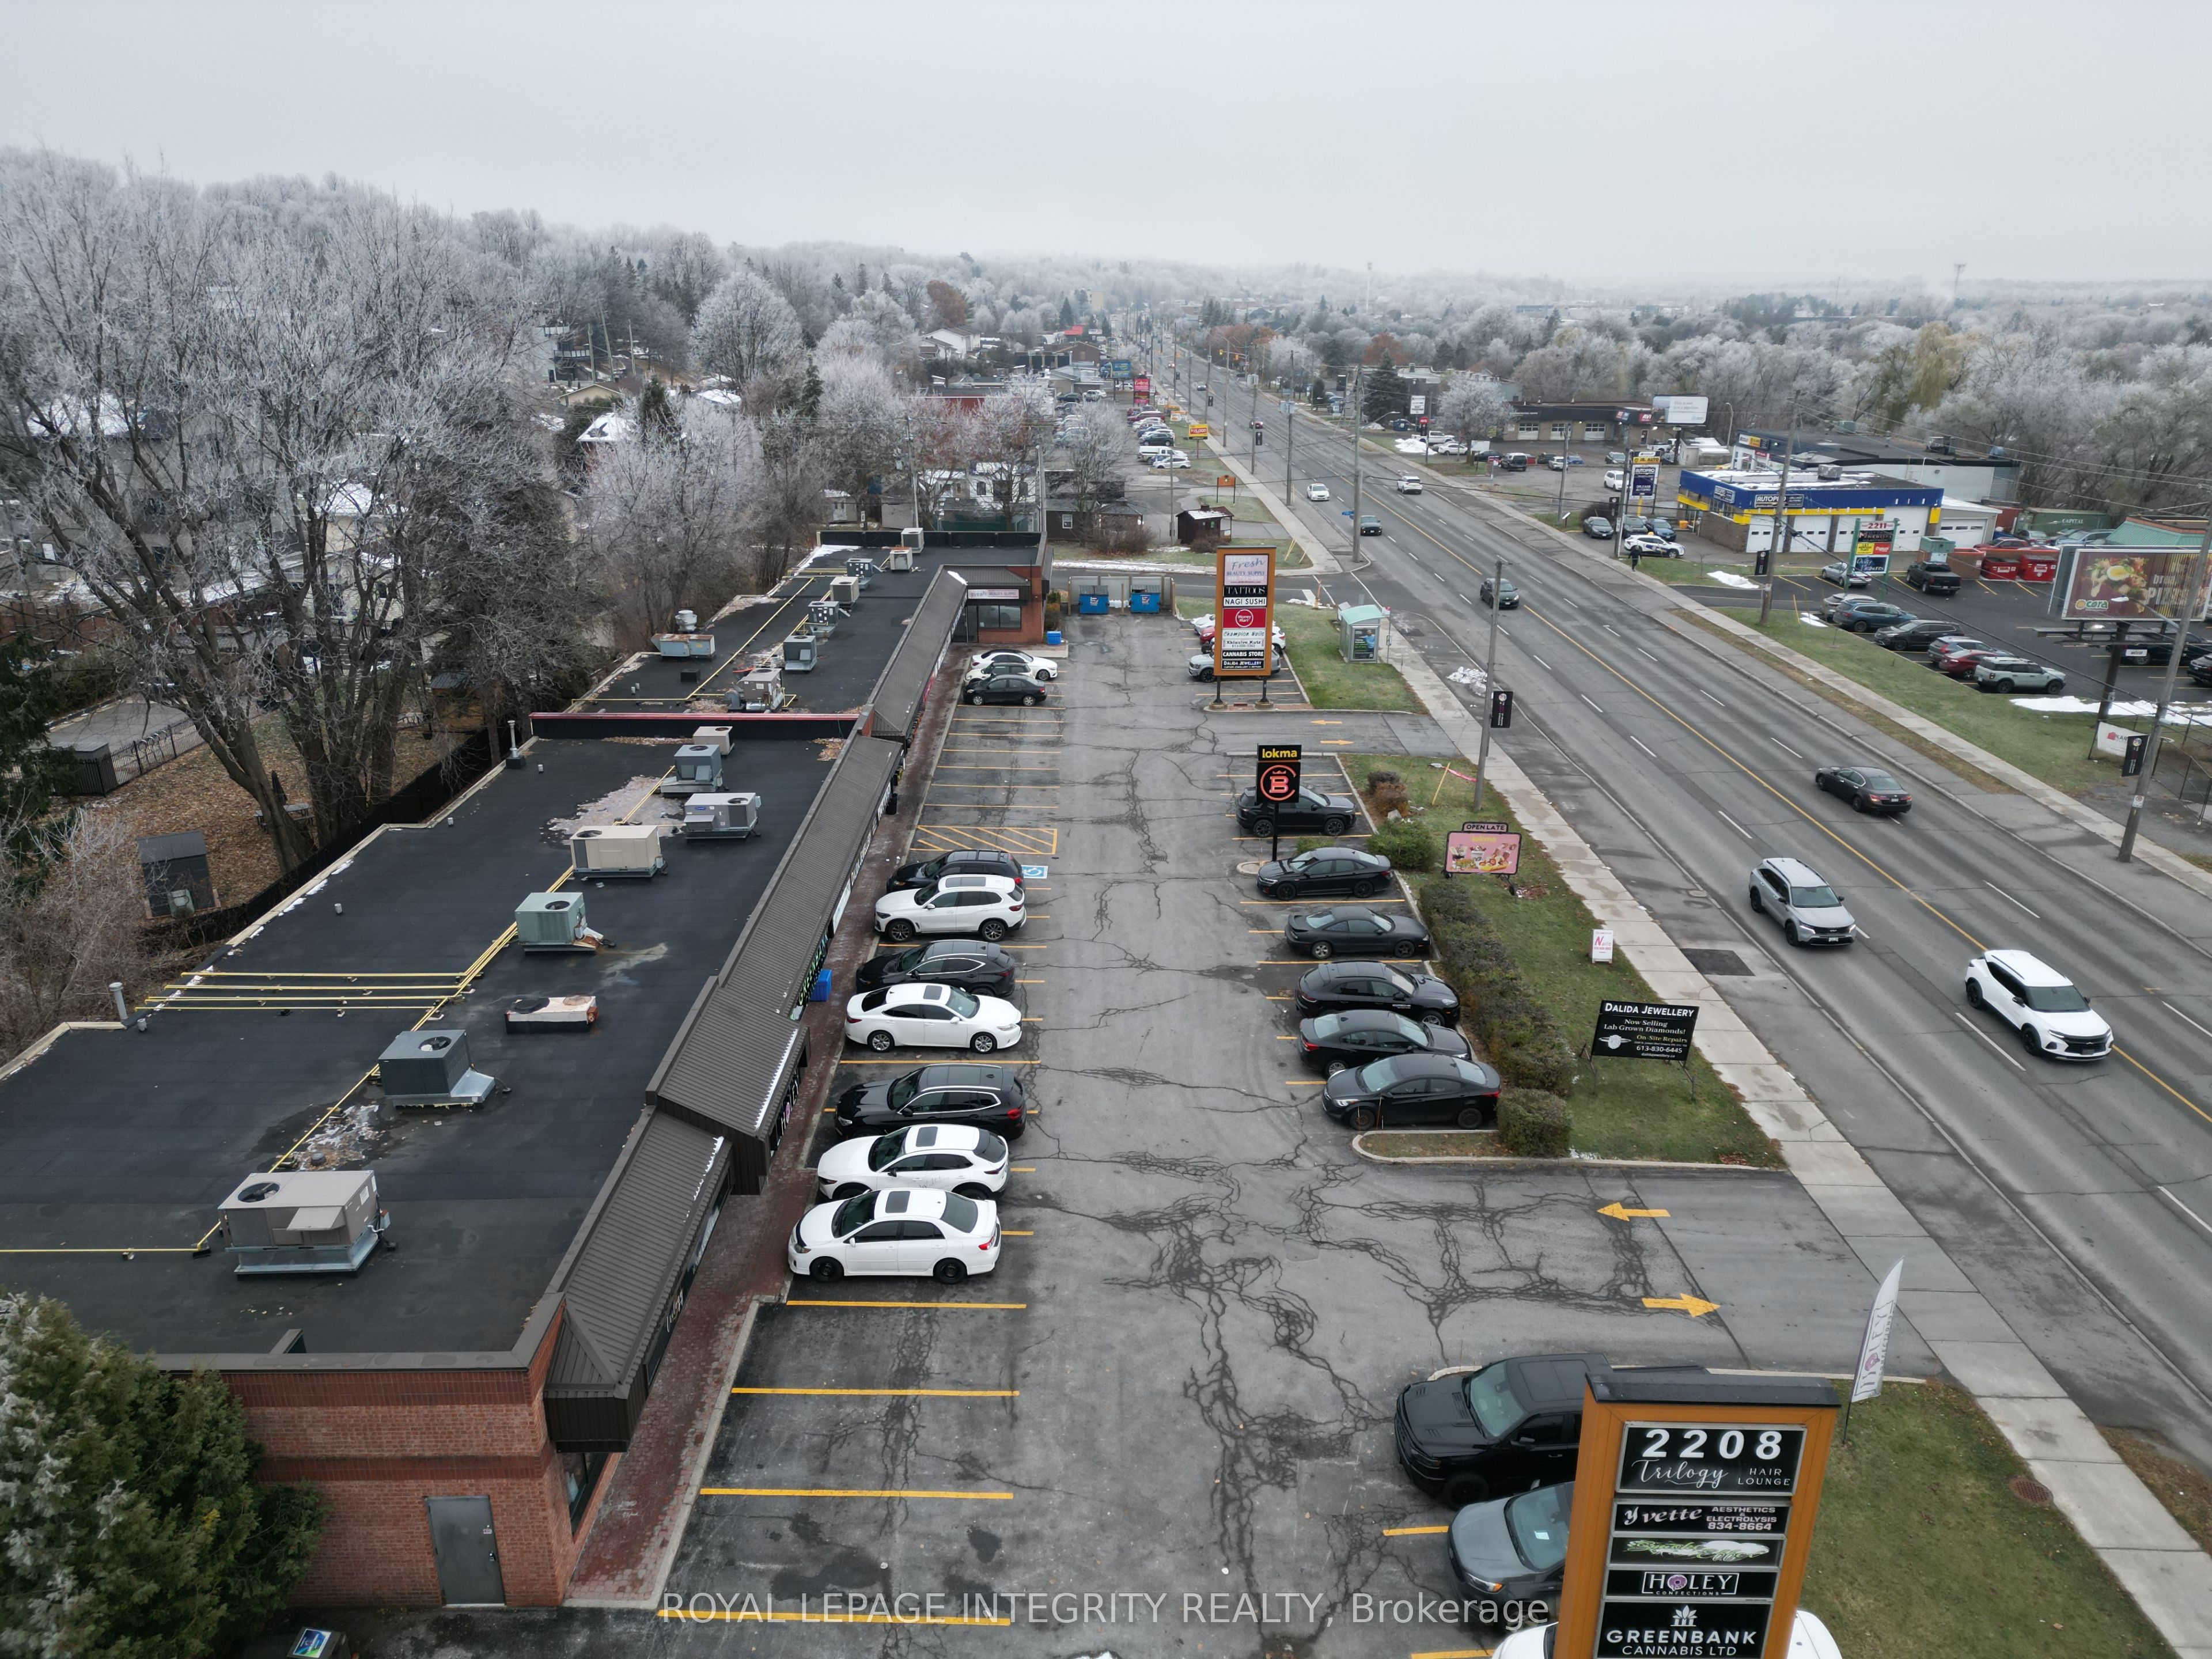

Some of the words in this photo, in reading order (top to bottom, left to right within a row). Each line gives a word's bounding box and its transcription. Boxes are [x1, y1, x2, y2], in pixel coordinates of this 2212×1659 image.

[1232, 558, 1266, 571] Fresh
[2085, 600, 2108, 609] cora
[1262, 748, 1297, 759] lokma
[1605, 1003, 1639, 1014] DALIDA
[1641, 1005, 1695, 1017] JEWELLERY
[1642, 1020, 1668, 1028] Selling
[1645, 1027, 1686, 1035] Diamonds!
[1636, 1045, 1683, 1054] 613-830-6445
[1642, 1429, 1782, 1460] 2208
[1631, 1459, 1729, 1489] Trilogy
[1737, 1478, 1791, 1486] LOUNGE
[1707, 1522, 1772, 1531] 834-8664
[1649, 1574, 1733, 1590] HOLEY
[1606, 1630, 1757, 1645] GREENBANK
[1622, 1645, 1703, 1656] CANNABIS
[1709, 1646, 1737, 1656] LTD
